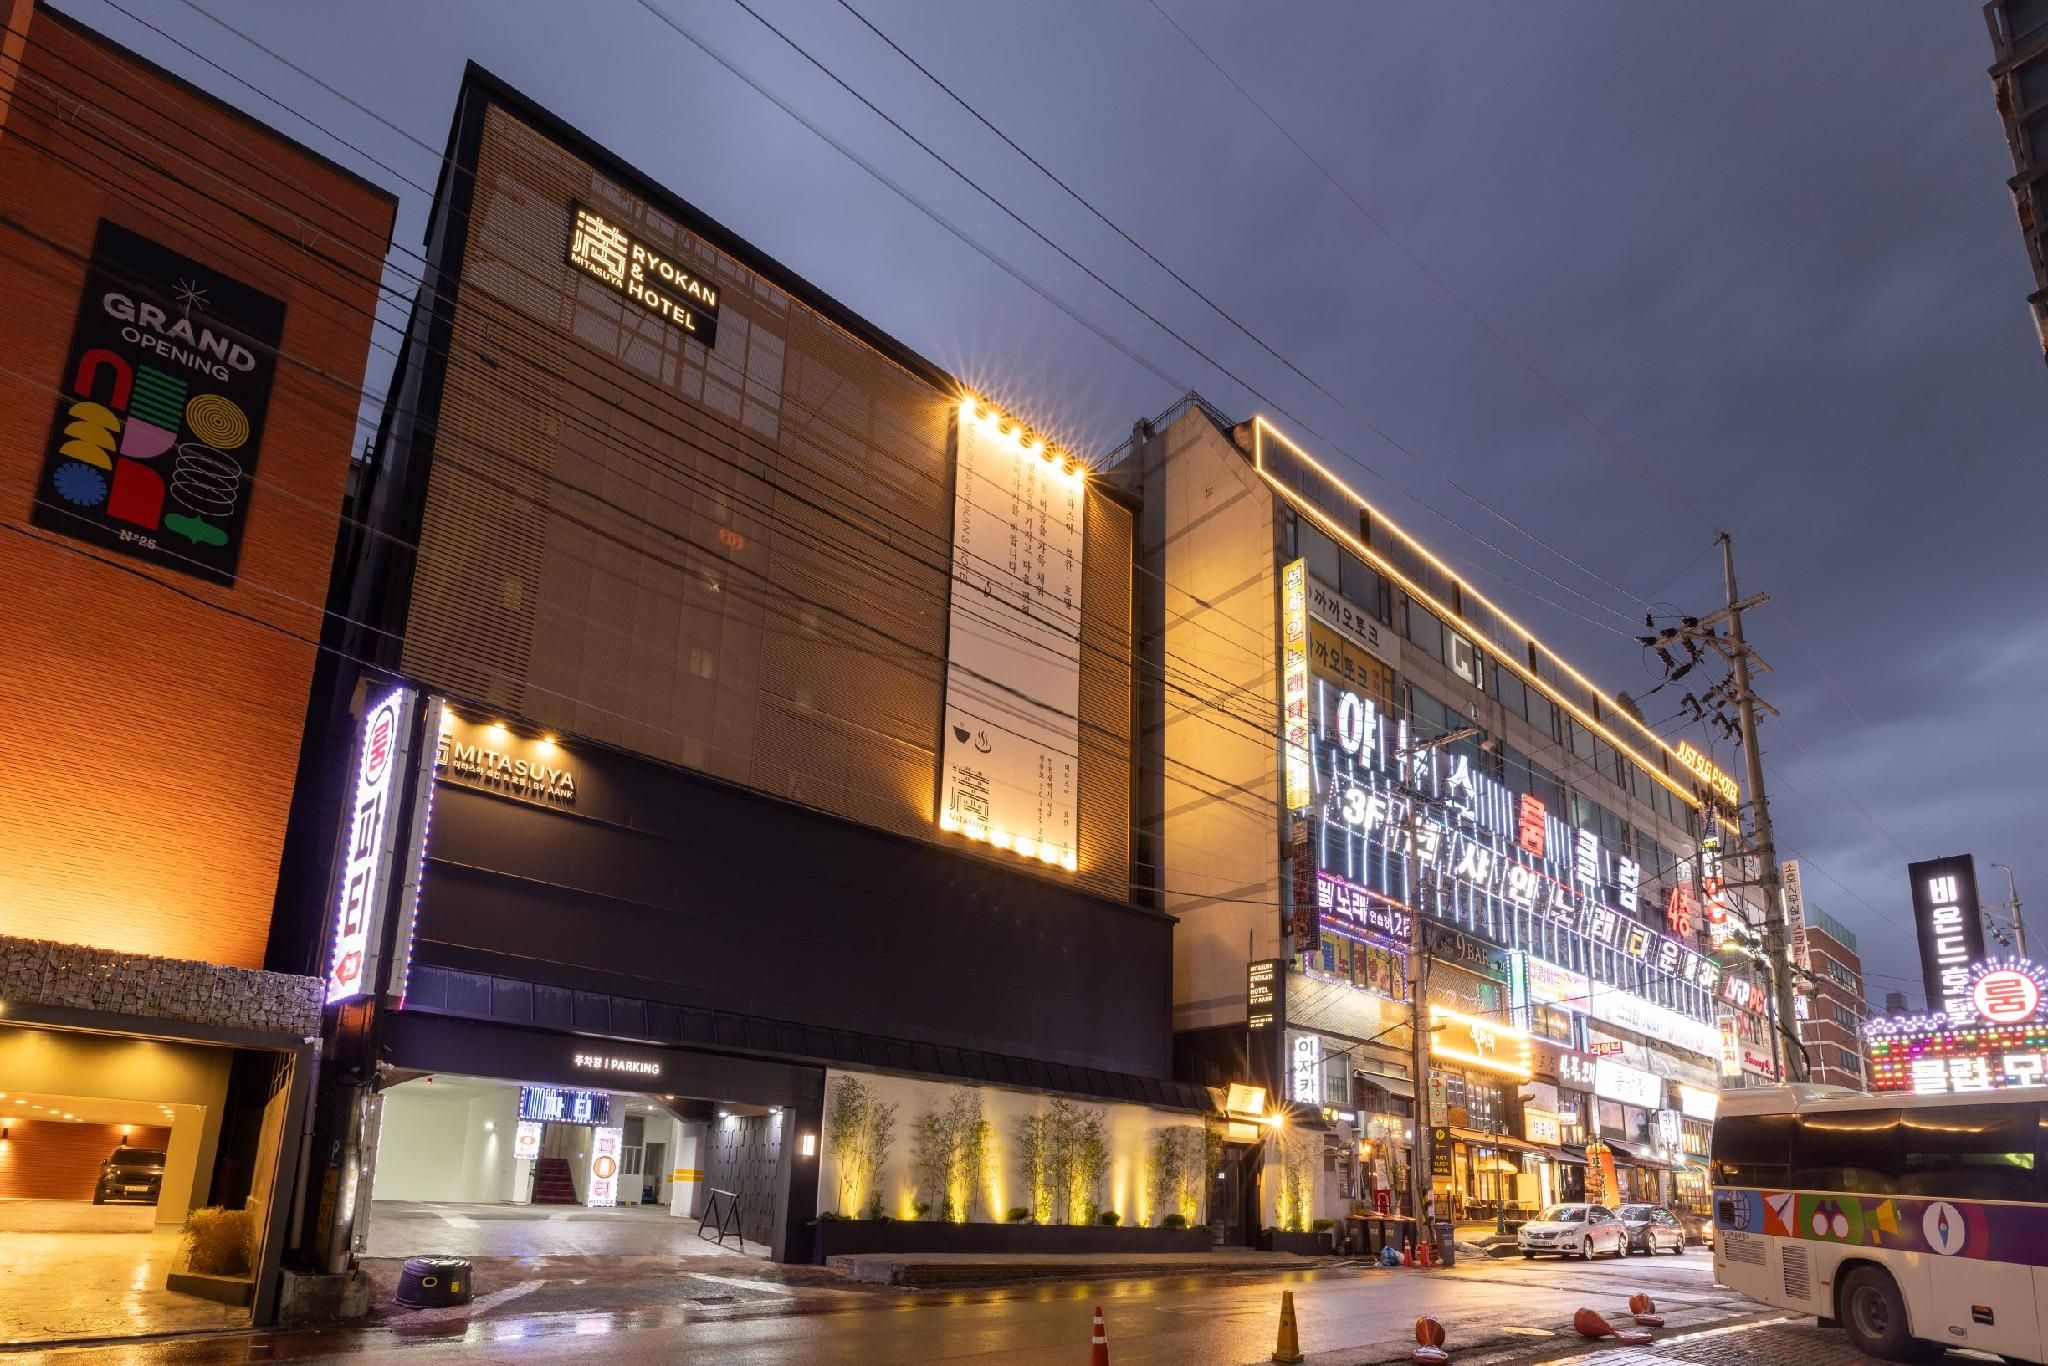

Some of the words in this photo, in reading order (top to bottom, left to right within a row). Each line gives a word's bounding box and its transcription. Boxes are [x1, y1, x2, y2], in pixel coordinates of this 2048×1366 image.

[571, 253, 622, 289] MITASUYA
[633, 245, 715, 306] RYOKAN
[629, 280, 695, 330] HOTEL
[103, 292, 256, 373] GRAND
[122, 326, 229, 383] OPENING
[453, 760, 484, 776] 미타스야
[534, 783, 545, 791] BY
[548, 787, 573, 798] AANK
[455, 742, 574, 790] MITASUYA
[1343, 788, 1387, 831] 3F
[575, 1055, 603, 1069] 주차장
[611, 1059, 660, 1075] PARKING
